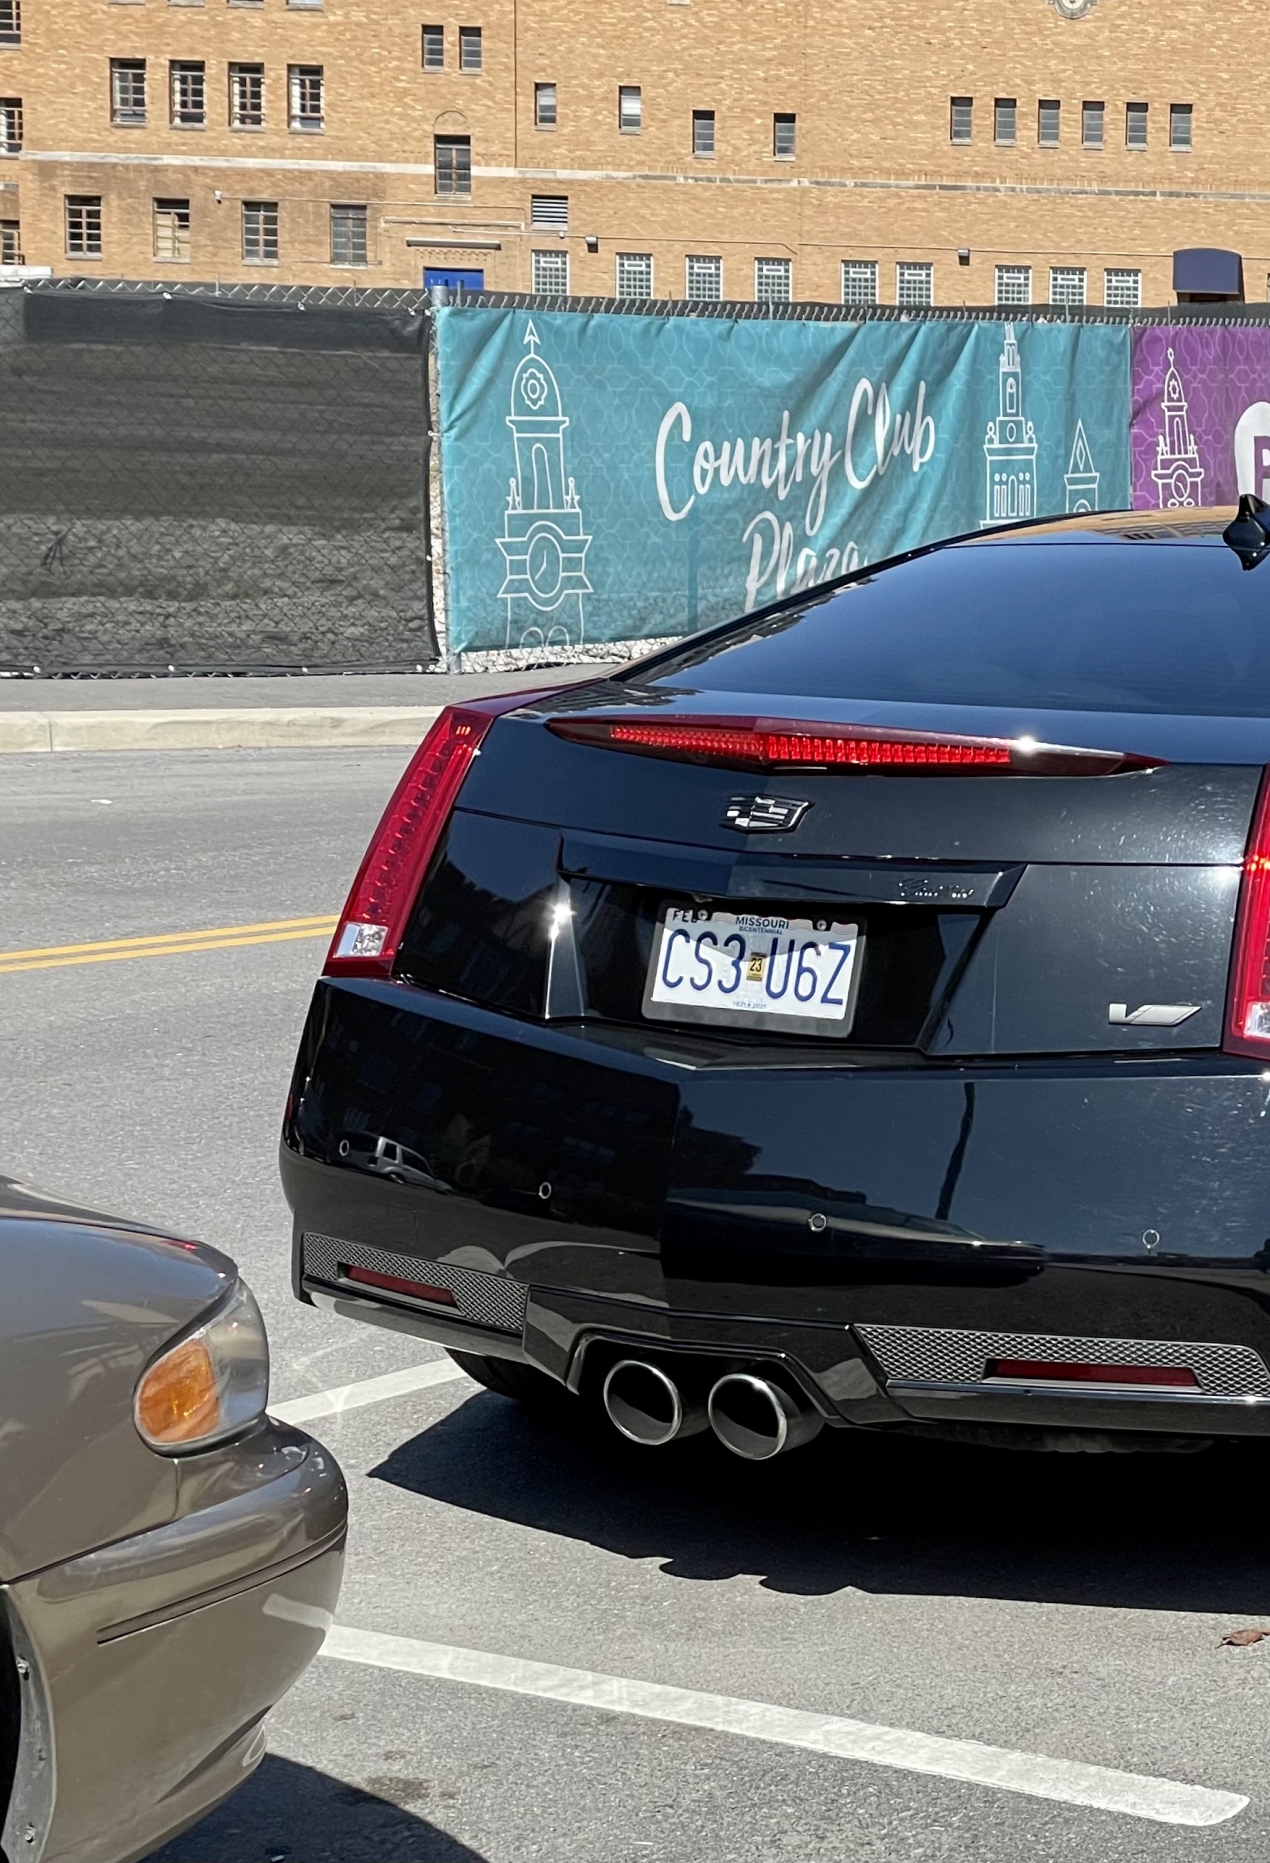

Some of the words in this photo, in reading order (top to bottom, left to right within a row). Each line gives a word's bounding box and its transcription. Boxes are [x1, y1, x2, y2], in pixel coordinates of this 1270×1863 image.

[655, 402, 841, 536] Country
[844, 378, 936, 490] Club
[735, 916, 790, 930] MISSOURI
[738, 925, 784, 935] BICENTENNIAL
[662, 928, 746, 994] CS3
[765, 937, 851, 1006] U6Z
[749, 957, 763, 973] 23
